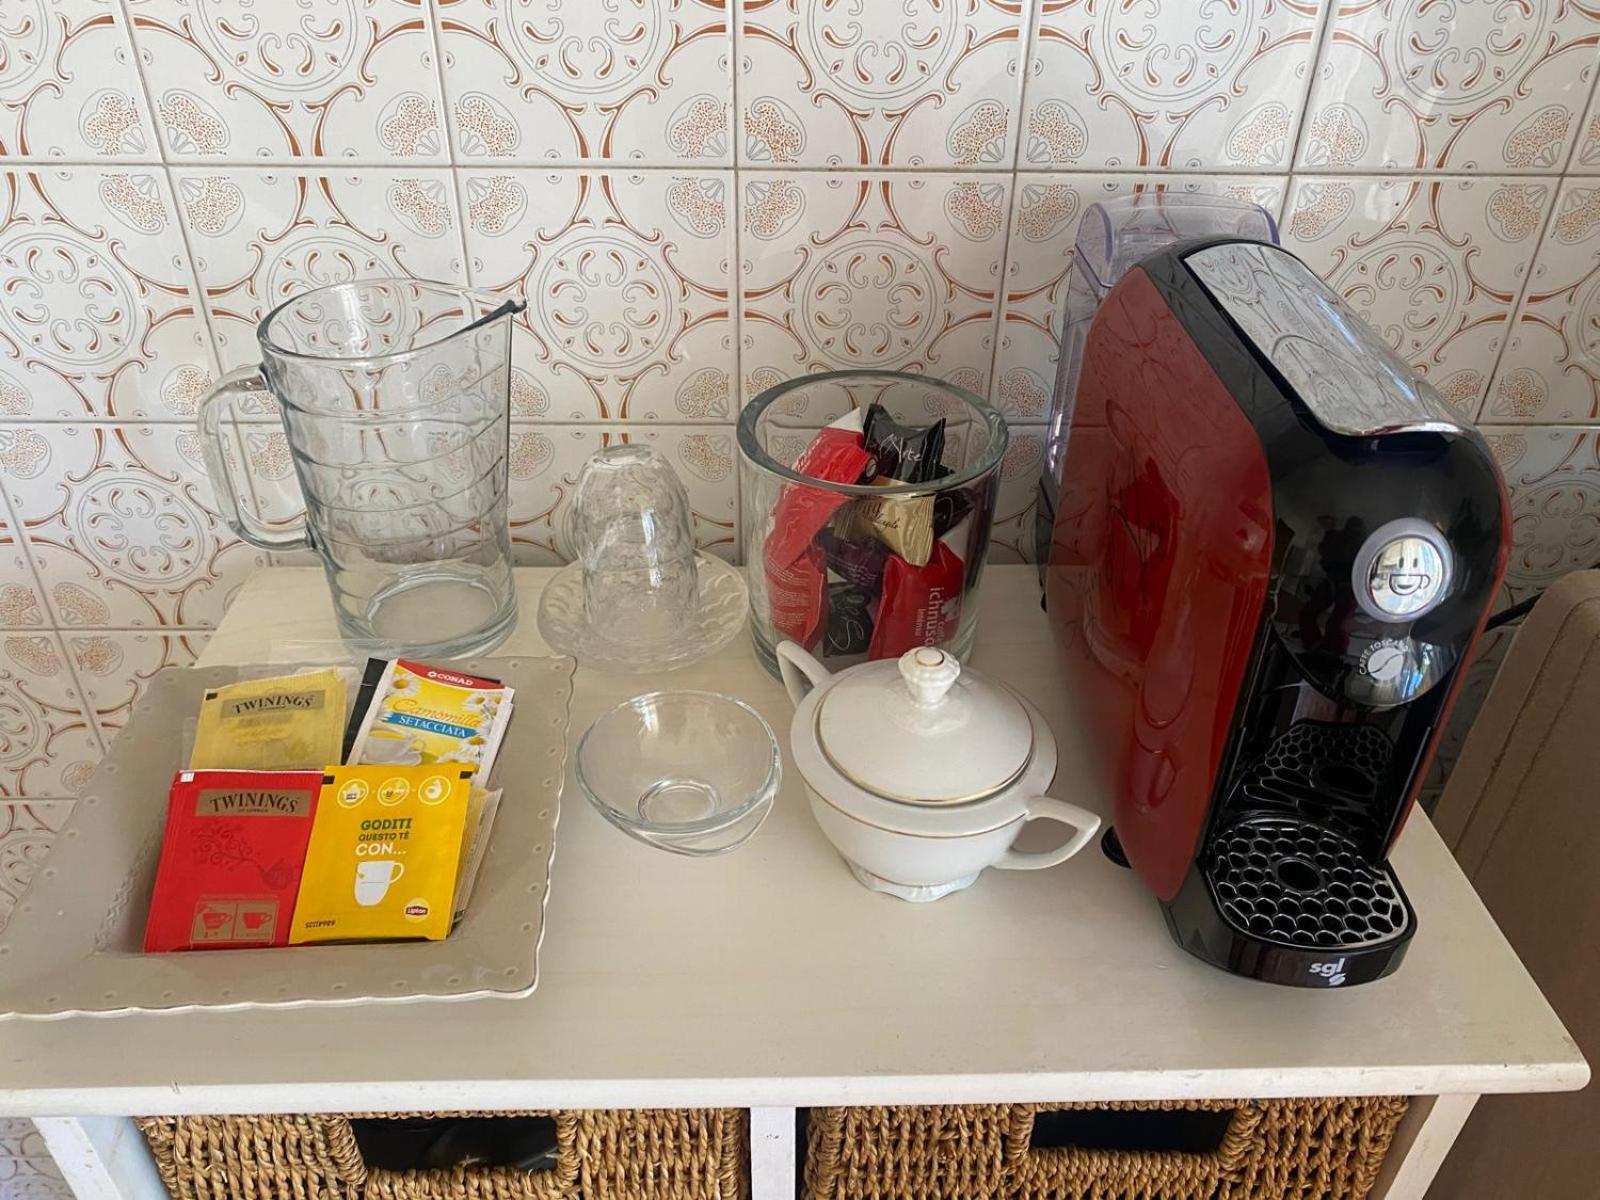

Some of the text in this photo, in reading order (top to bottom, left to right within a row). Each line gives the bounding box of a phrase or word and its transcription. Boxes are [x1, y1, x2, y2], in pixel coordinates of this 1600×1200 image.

[925, 587, 945, 646] ichnusa
[437, 673, 474, 687] CONAD
[233, 694, 314, 714] TWININGS
[392, 698, 482, 728] Camomilla
[399, 714, 466, 738] SETACCIATA
[210, 791, 298, 813] TWININGS
[361, 817, 413, 831] GODITI
[358, 832, 397, 842] QUESTO
[355, 842, 407, 857] CON...
[1309, 957, 1346, 977] sgl
